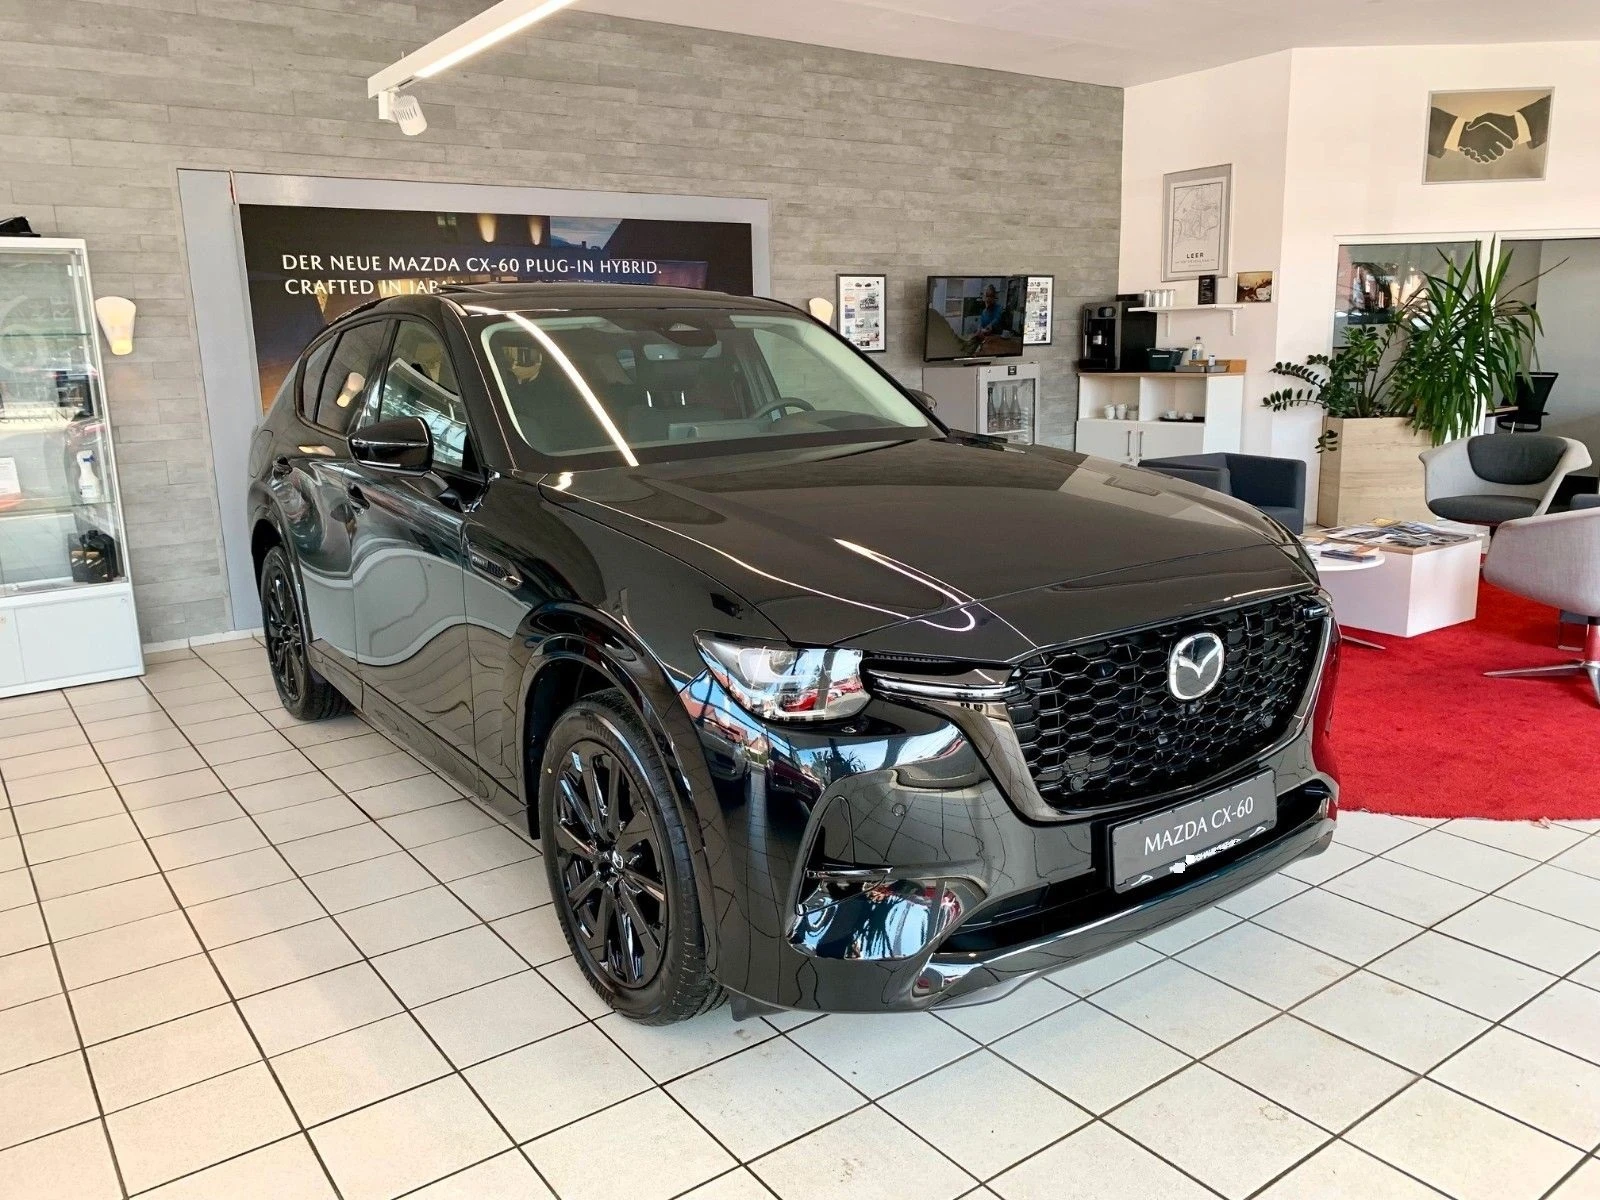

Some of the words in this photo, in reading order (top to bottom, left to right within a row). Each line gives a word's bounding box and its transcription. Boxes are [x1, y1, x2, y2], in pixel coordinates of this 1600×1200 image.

[282, 254, 323, 271] DER
[330, 256, 381, 272] NEUE
[388, 257, 460, 273] MAZDA
[466, 257, 519, 273] CX-60
[526, 259, 594, 274] PLUG-IN
[600, 260, 662, 275] HYBRID.
[284, 279, 374, 295] CRAFTED
[381, 280, 401, 295] IN
[1144, 816, 1208, 856] MAZDA
[1211, 796, 1254, 829] CX-60
